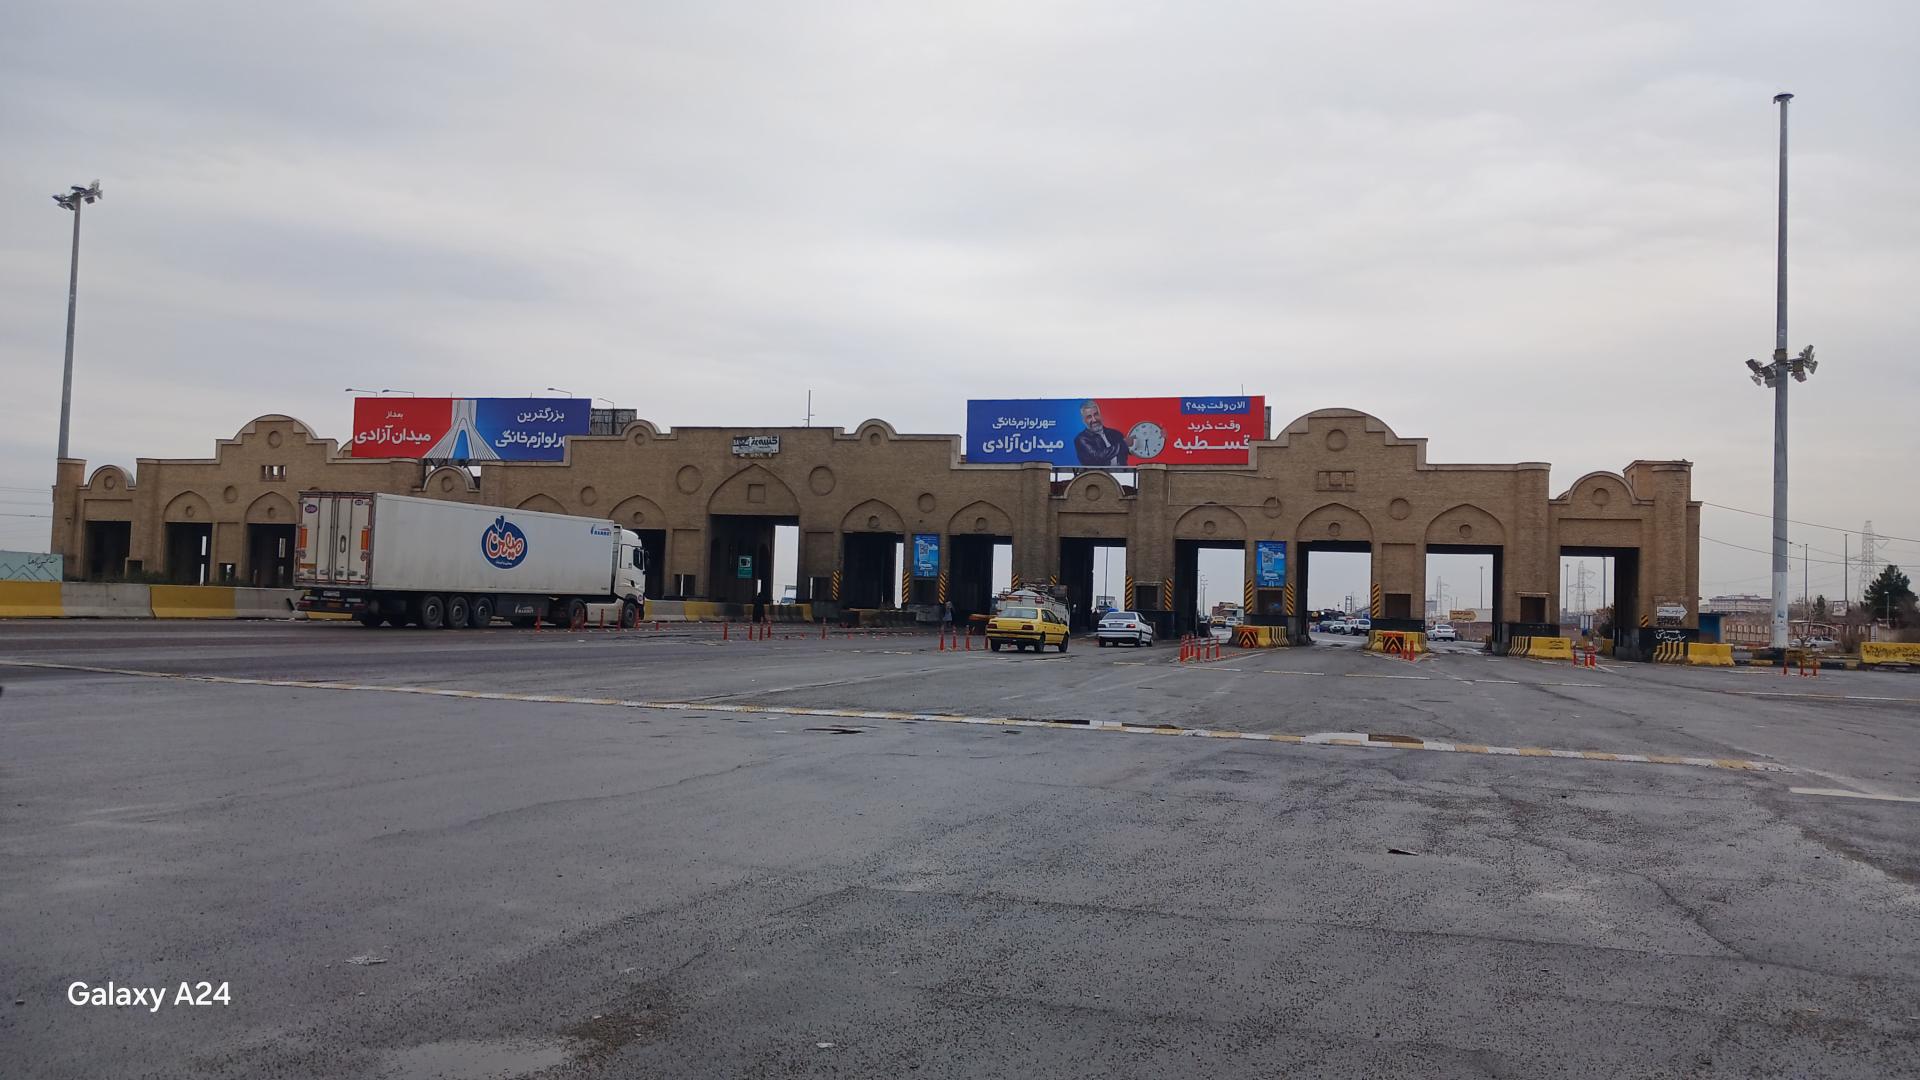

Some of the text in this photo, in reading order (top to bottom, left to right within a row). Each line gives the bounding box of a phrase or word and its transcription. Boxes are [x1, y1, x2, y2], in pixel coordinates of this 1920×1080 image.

[1186, 401, 1246, 412] الان وقت چیه؟
[517, 407, 564, 423] بزرگترین
[992, 417, 1016, 429] خانگی
[1015, 417, 1038, 429] لوازم
[1187, 420, 1241, 432] وقت خرید
[354, 424, 431, 445] میدان آزادی
[495, 430, 528, 448] خانگی
[526, 432, 557, 448] لوازم
[982, 433, 1064, 453] میدان آزادی
[1173, 434, 1250, 454] قسطیه
[486, 530, 524, 560] میهن
